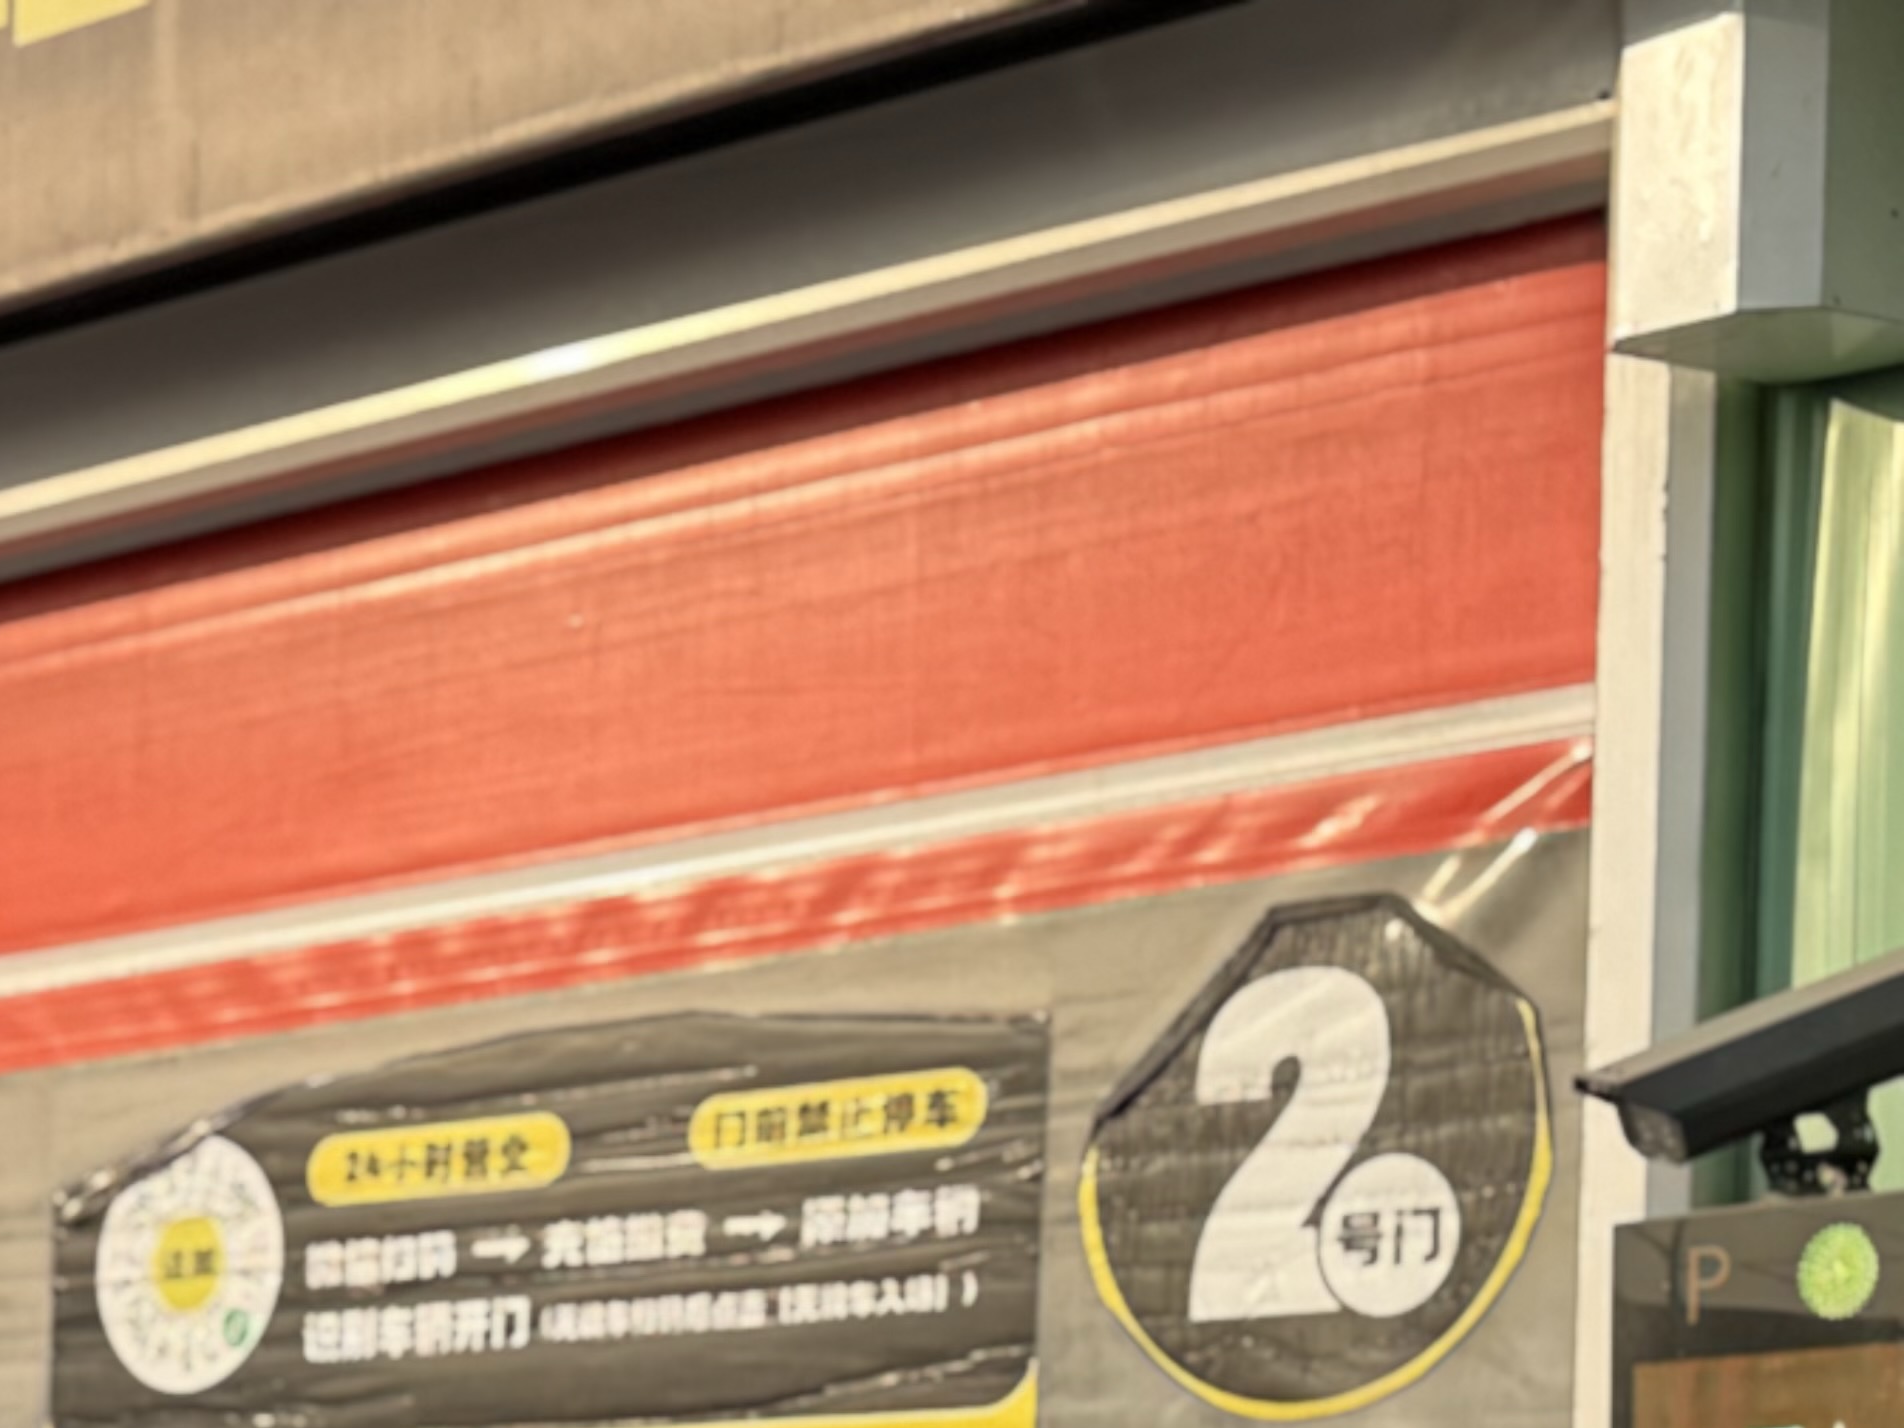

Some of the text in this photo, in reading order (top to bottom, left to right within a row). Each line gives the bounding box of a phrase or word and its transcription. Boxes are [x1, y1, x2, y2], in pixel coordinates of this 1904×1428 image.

[1188, 964, 1444, 1324] 2 号门
[1687, 1245, 1731, 1325] P
